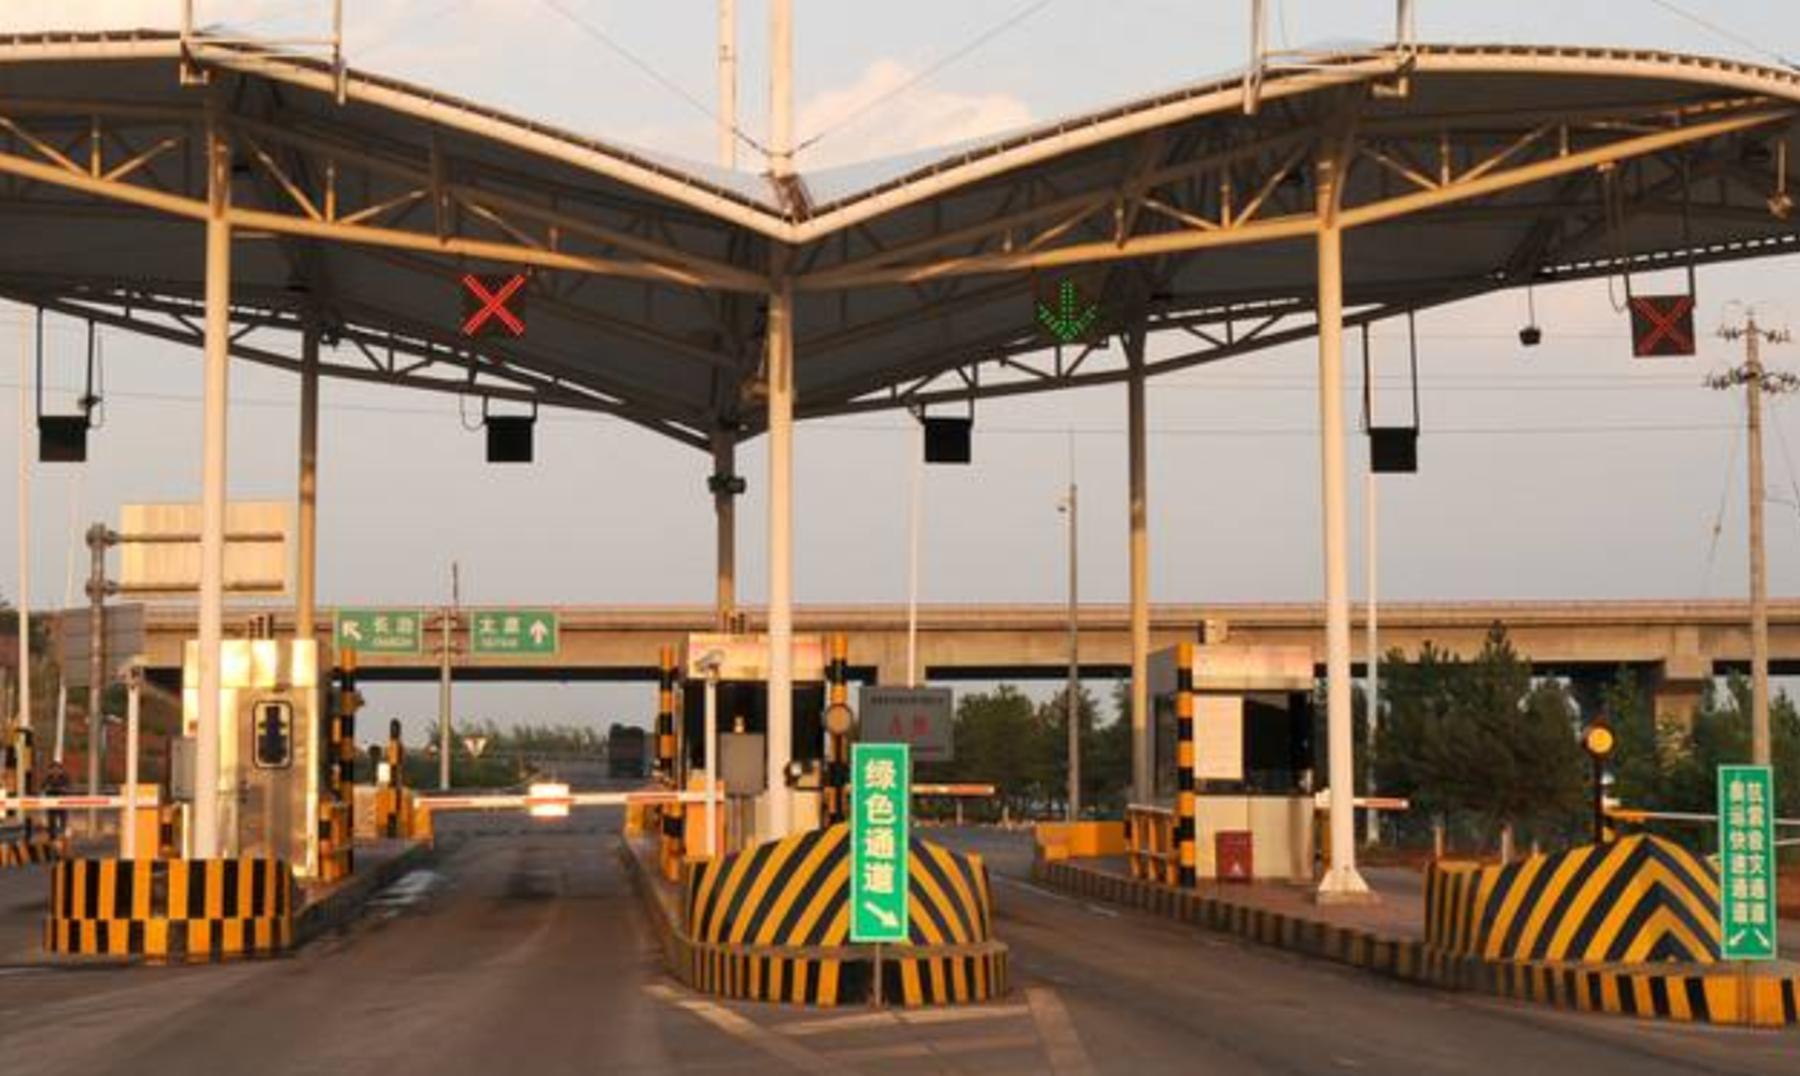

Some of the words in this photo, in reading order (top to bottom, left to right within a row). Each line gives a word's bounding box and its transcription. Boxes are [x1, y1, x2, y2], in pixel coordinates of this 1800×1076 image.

[864, 758, 897, 894] 绿色通道
[1747, 780, 1767, 924] 抗震救灾通道
